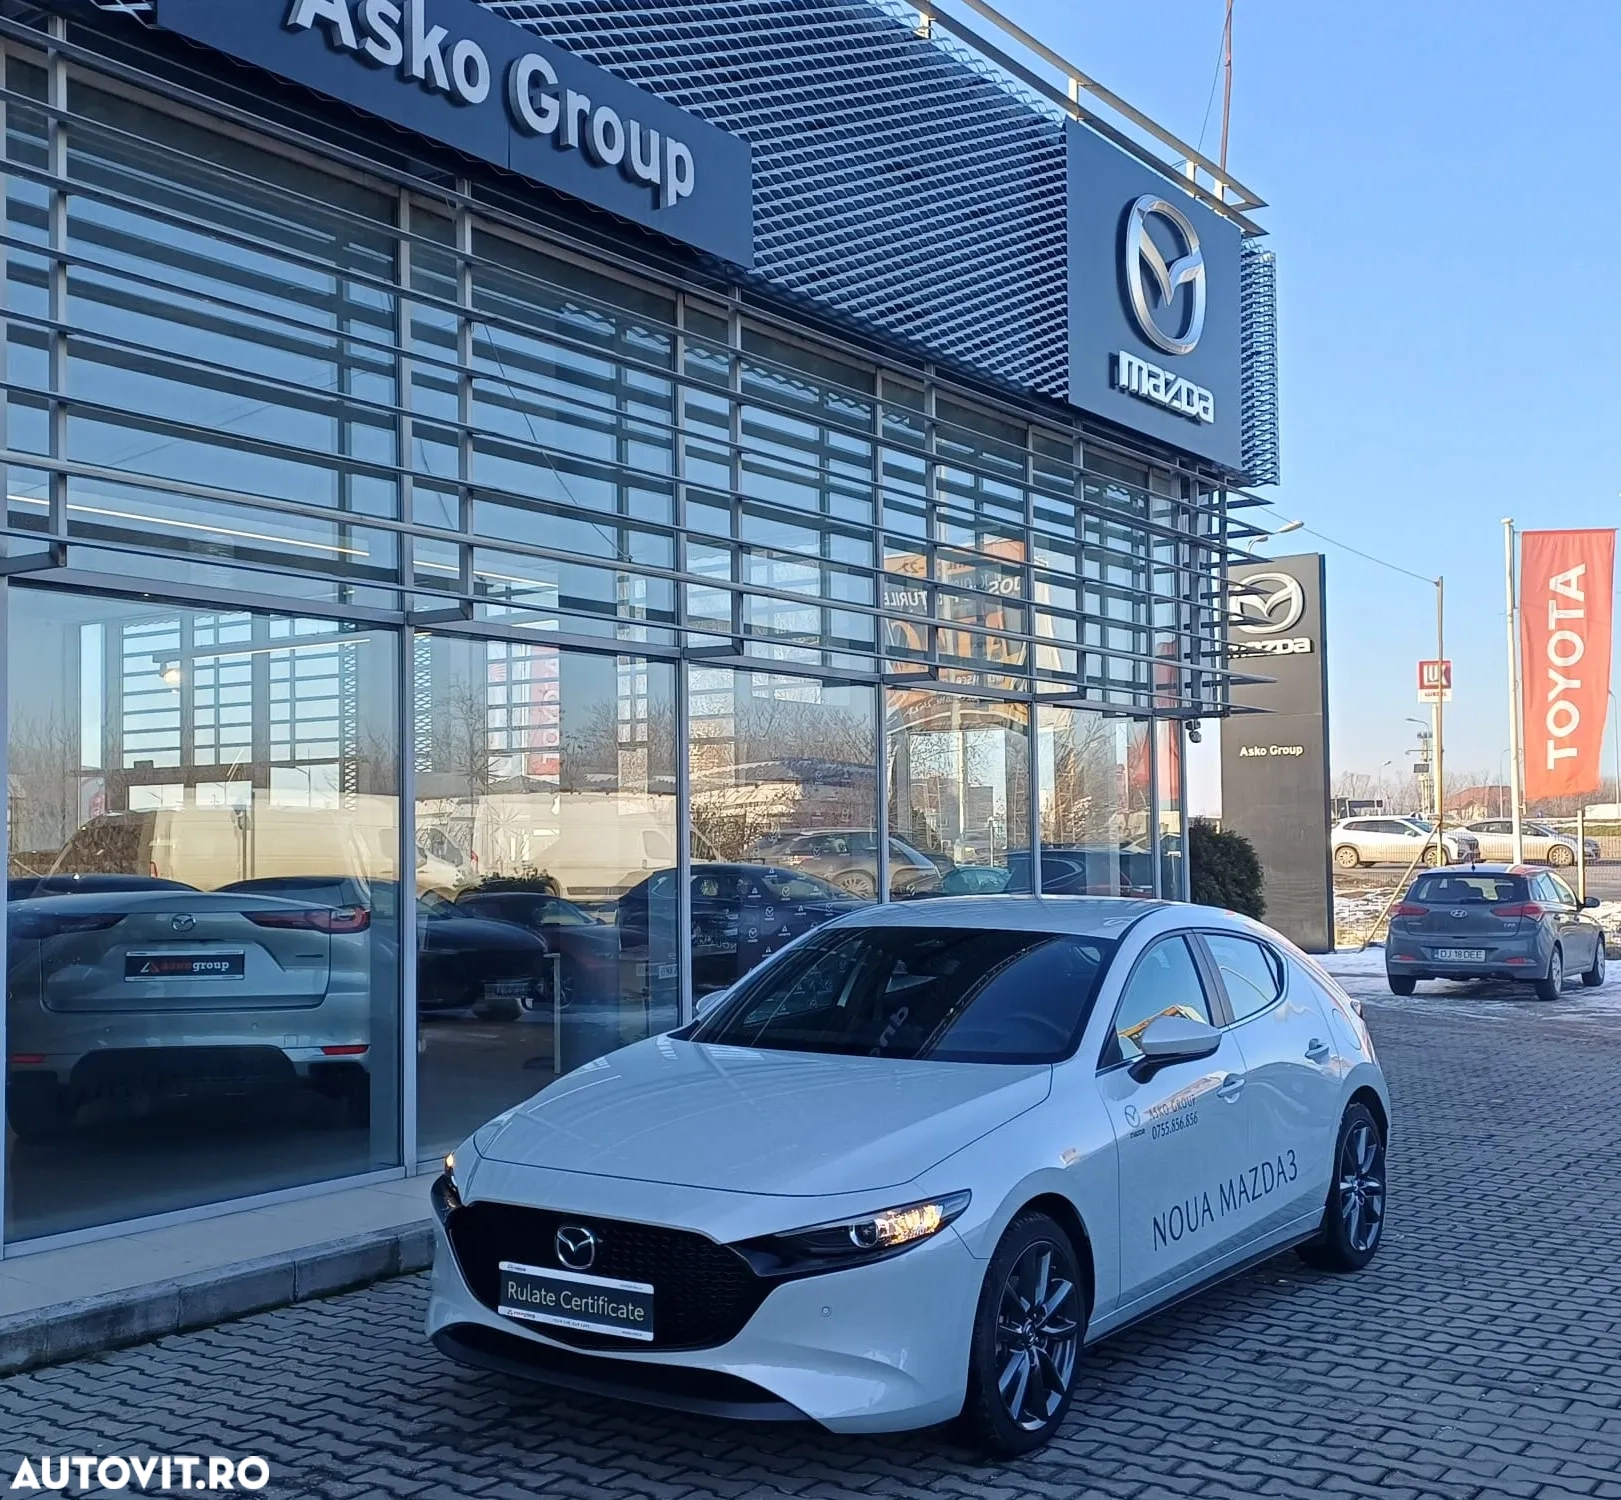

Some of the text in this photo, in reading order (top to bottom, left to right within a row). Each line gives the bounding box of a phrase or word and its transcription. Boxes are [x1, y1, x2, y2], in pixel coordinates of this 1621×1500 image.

[511, 52, 695, 208] Group
[1118, 350, 1215, 424] mazda
[1546, 563, 1587, 770] TOYOTA
[1239, 744, 1303, 758] Asko Group
[1151, 1111, 1199, 1141] 0755.856.856
[1153, 1149, 1299, 1252] NOUA MAZDA3
[507, 1281, 645, 1322] Rulate Certificate
